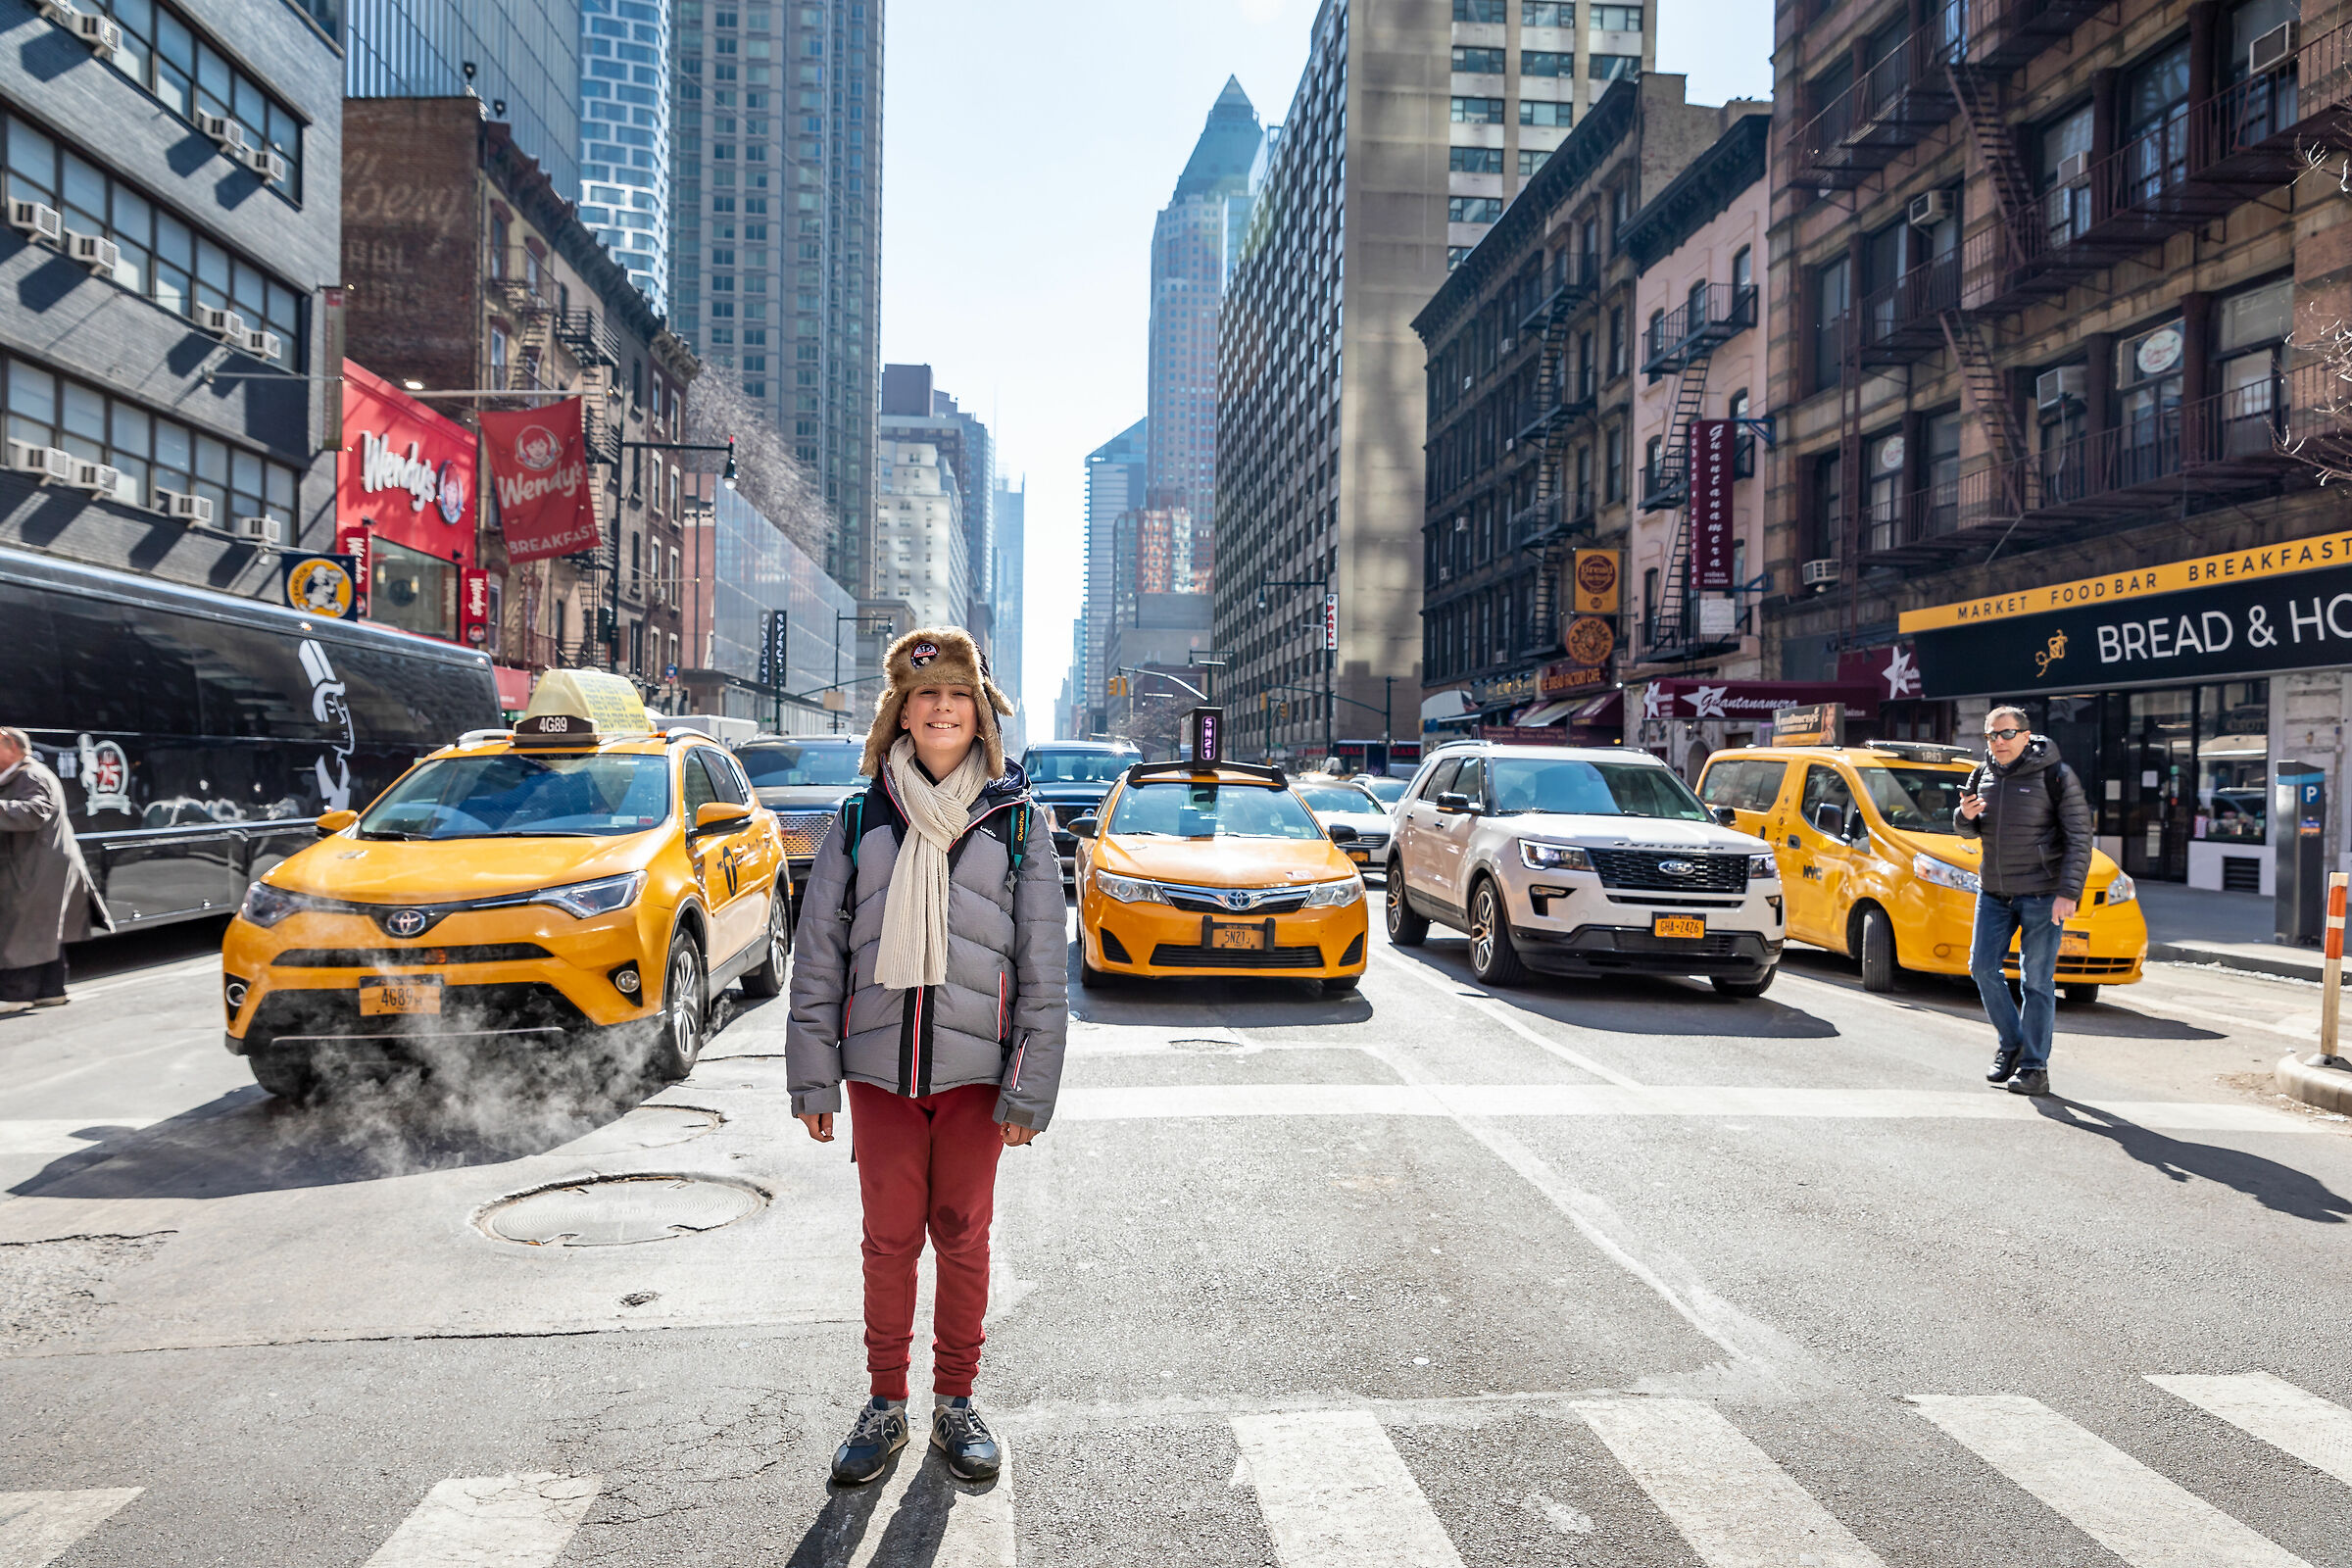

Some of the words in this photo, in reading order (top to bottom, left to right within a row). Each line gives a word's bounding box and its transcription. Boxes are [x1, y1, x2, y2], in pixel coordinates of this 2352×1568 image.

[363, 430, 437, 512] Wendy's
[498, 461, 584, 509] Wendy's
[509, 523, 595, 555] BREAKFAST
[1957, 596, 2028, 619] MARKET
[2188, 538, 2352, 581] BREAKFAST
[2096, 611, 2233, 663] BREAD
[2246, 605, 2278, 648] &
[539, 717, 567, 733] 4G89
[98, 764, 122, 792] 25
[1803, 865, 1823, 880] NYC
